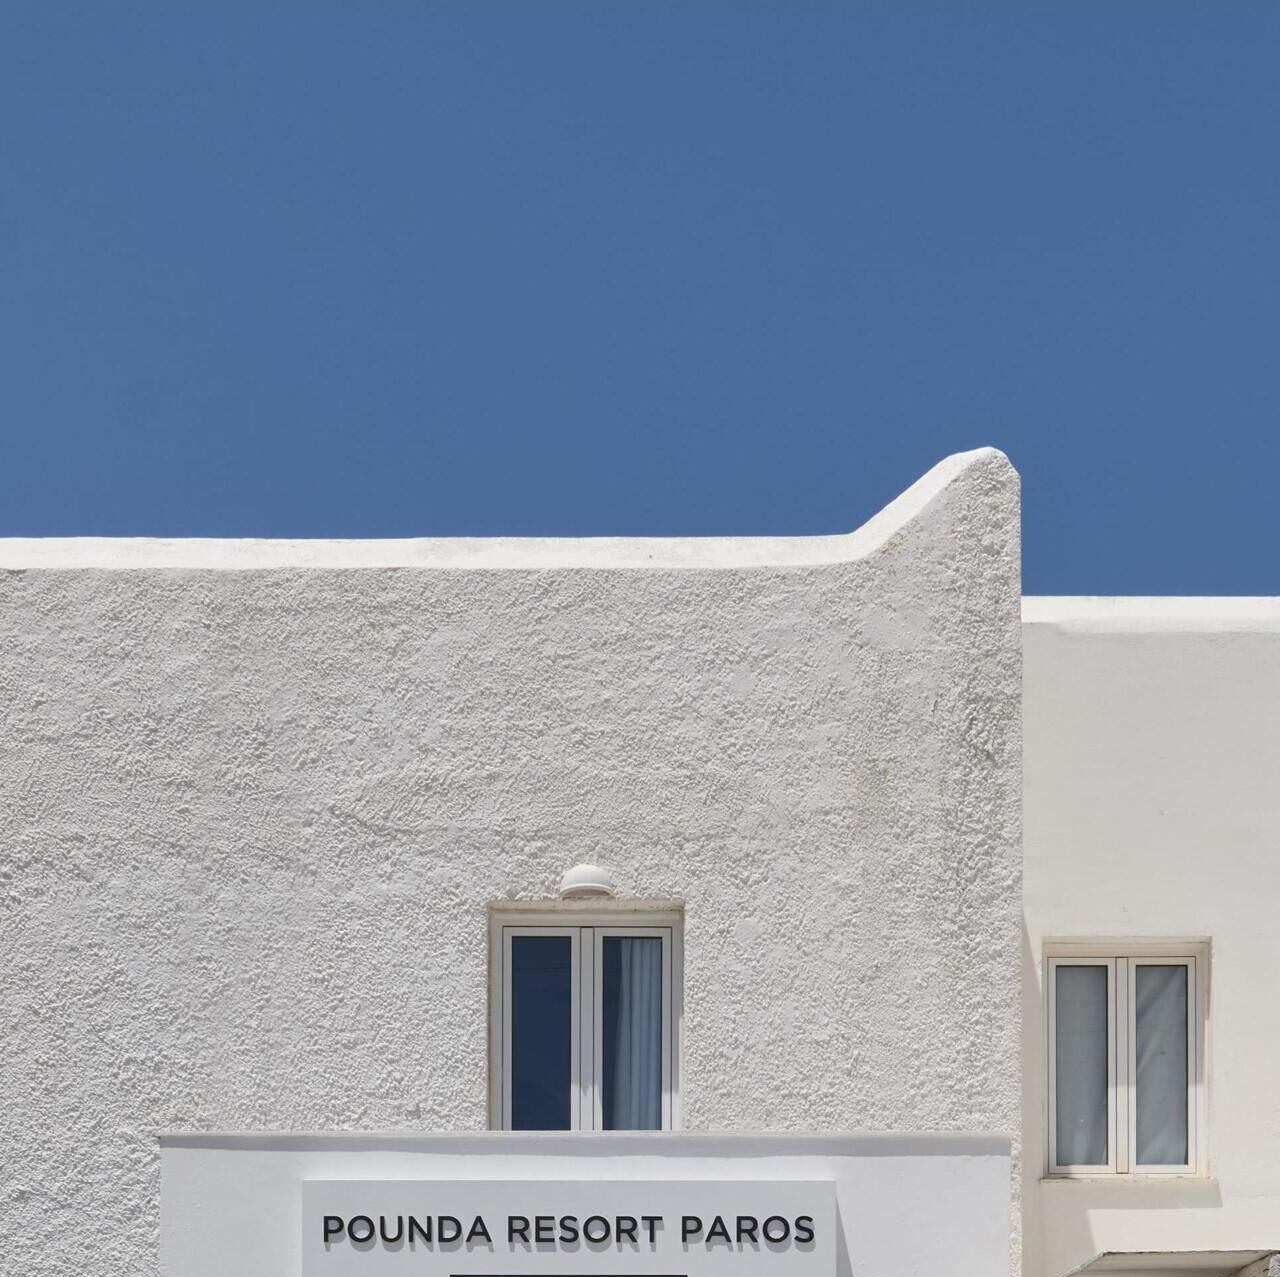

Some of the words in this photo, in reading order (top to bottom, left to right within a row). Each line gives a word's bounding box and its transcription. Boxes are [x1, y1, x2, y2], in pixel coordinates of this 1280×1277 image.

[323, 1215, 492, 1244] POUNDA
[507, 1215, 663, 1244] RESORT
[681, 1215, 815, 1244] PAROS
